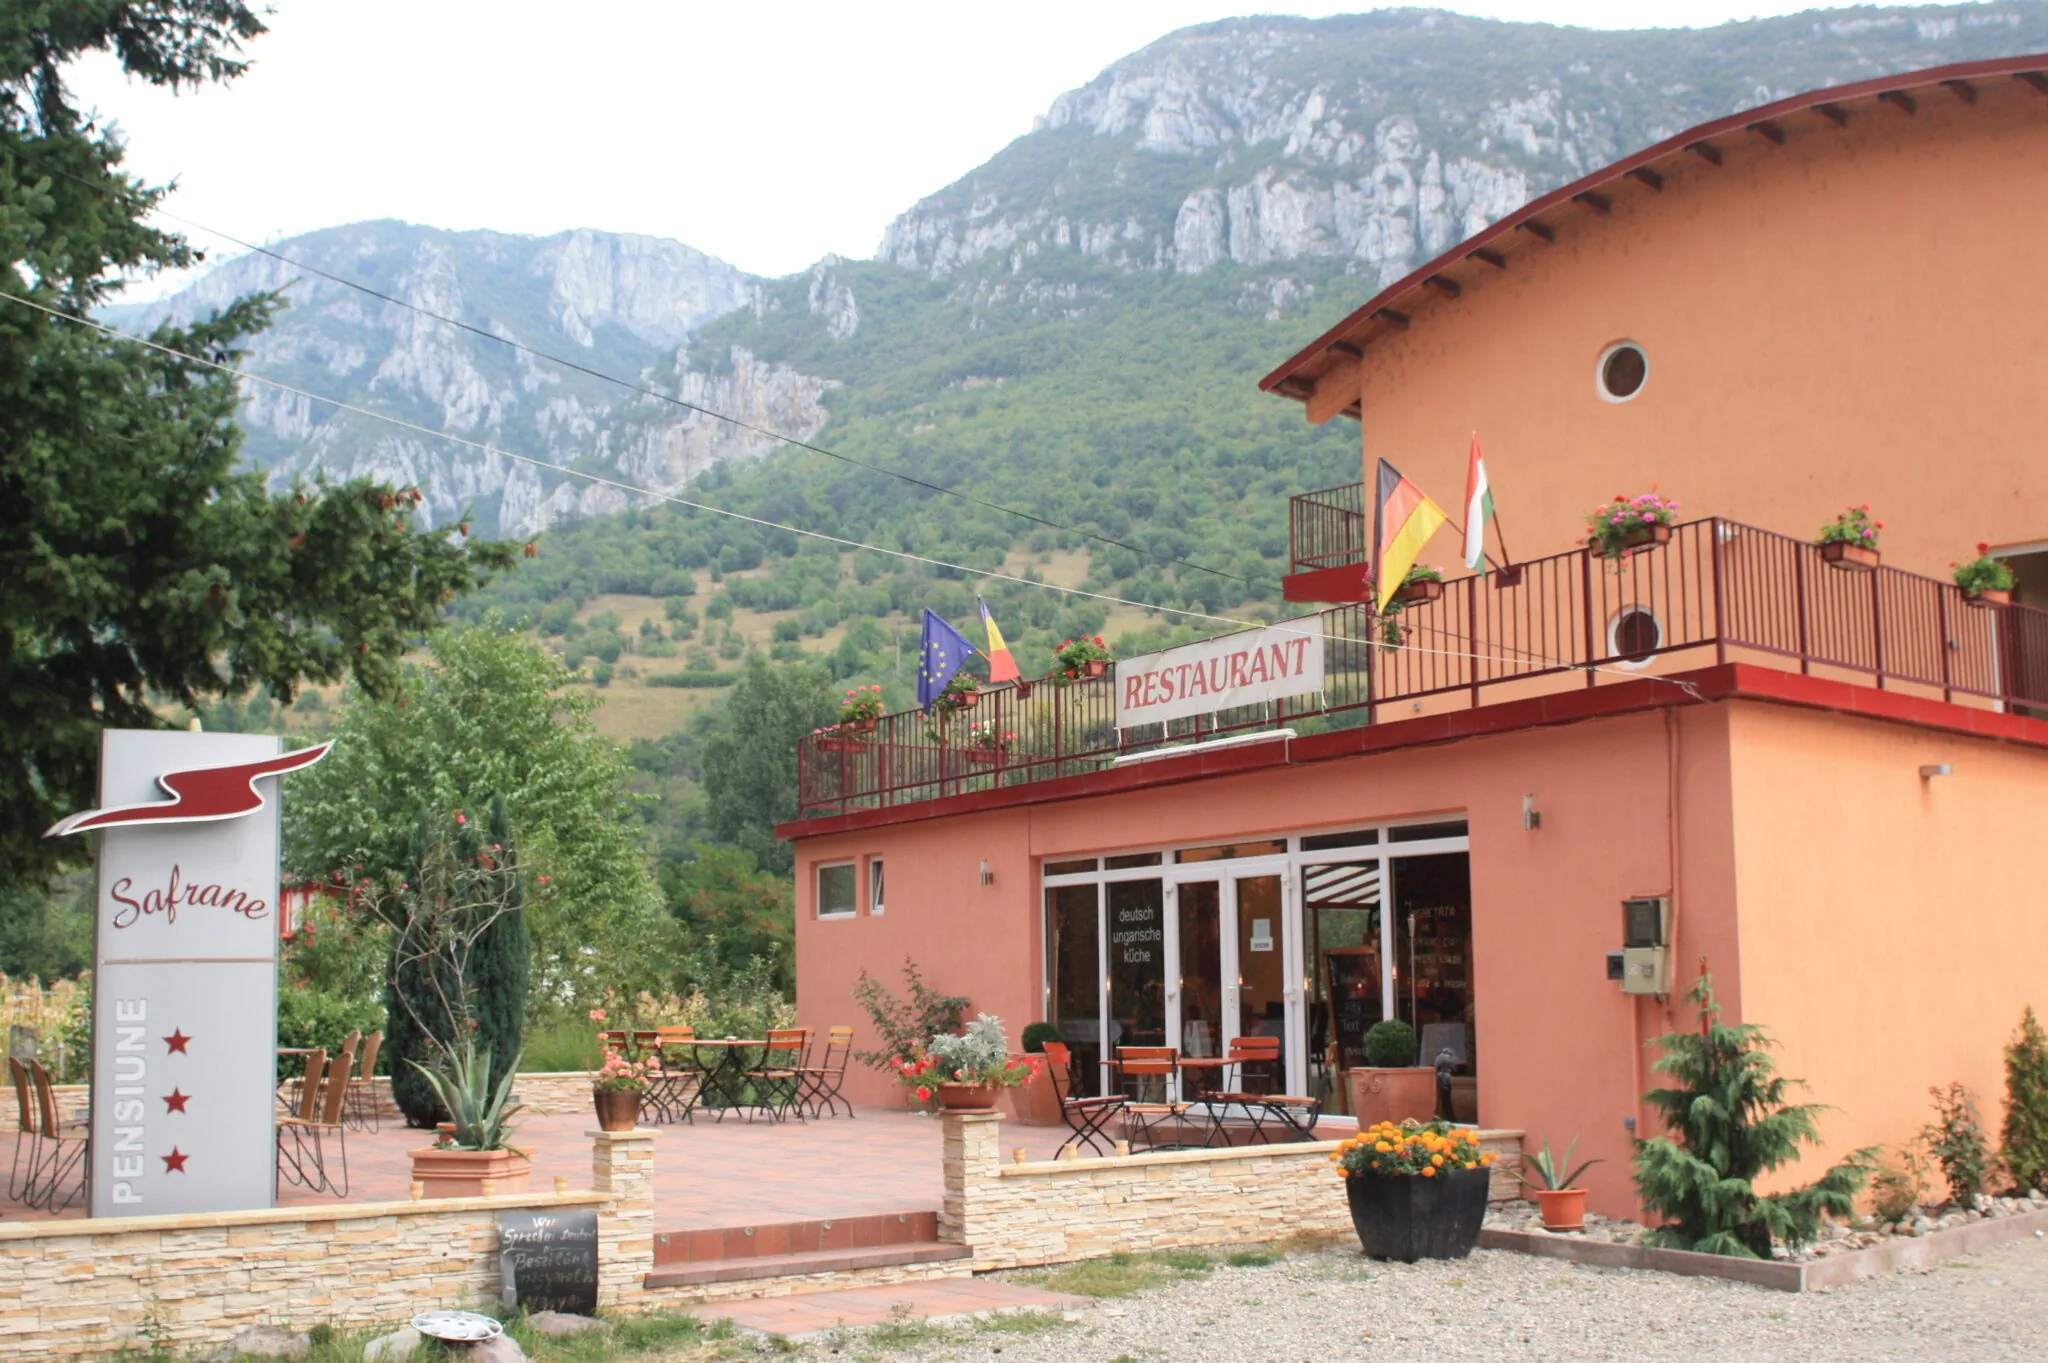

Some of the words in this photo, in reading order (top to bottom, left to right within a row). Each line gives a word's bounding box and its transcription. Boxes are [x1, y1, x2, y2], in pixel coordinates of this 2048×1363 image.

[1124, 636, 1312, 710] RESTAURANT
[111, 863, 269, 929] Safrane
[1119, 906, 1154, 922] deutsch
[1113, 927, 1161, 946] ungarische
[1123, 947, 1151, 963] küche
[112, 998, 147, 1205] PENSIUNE
